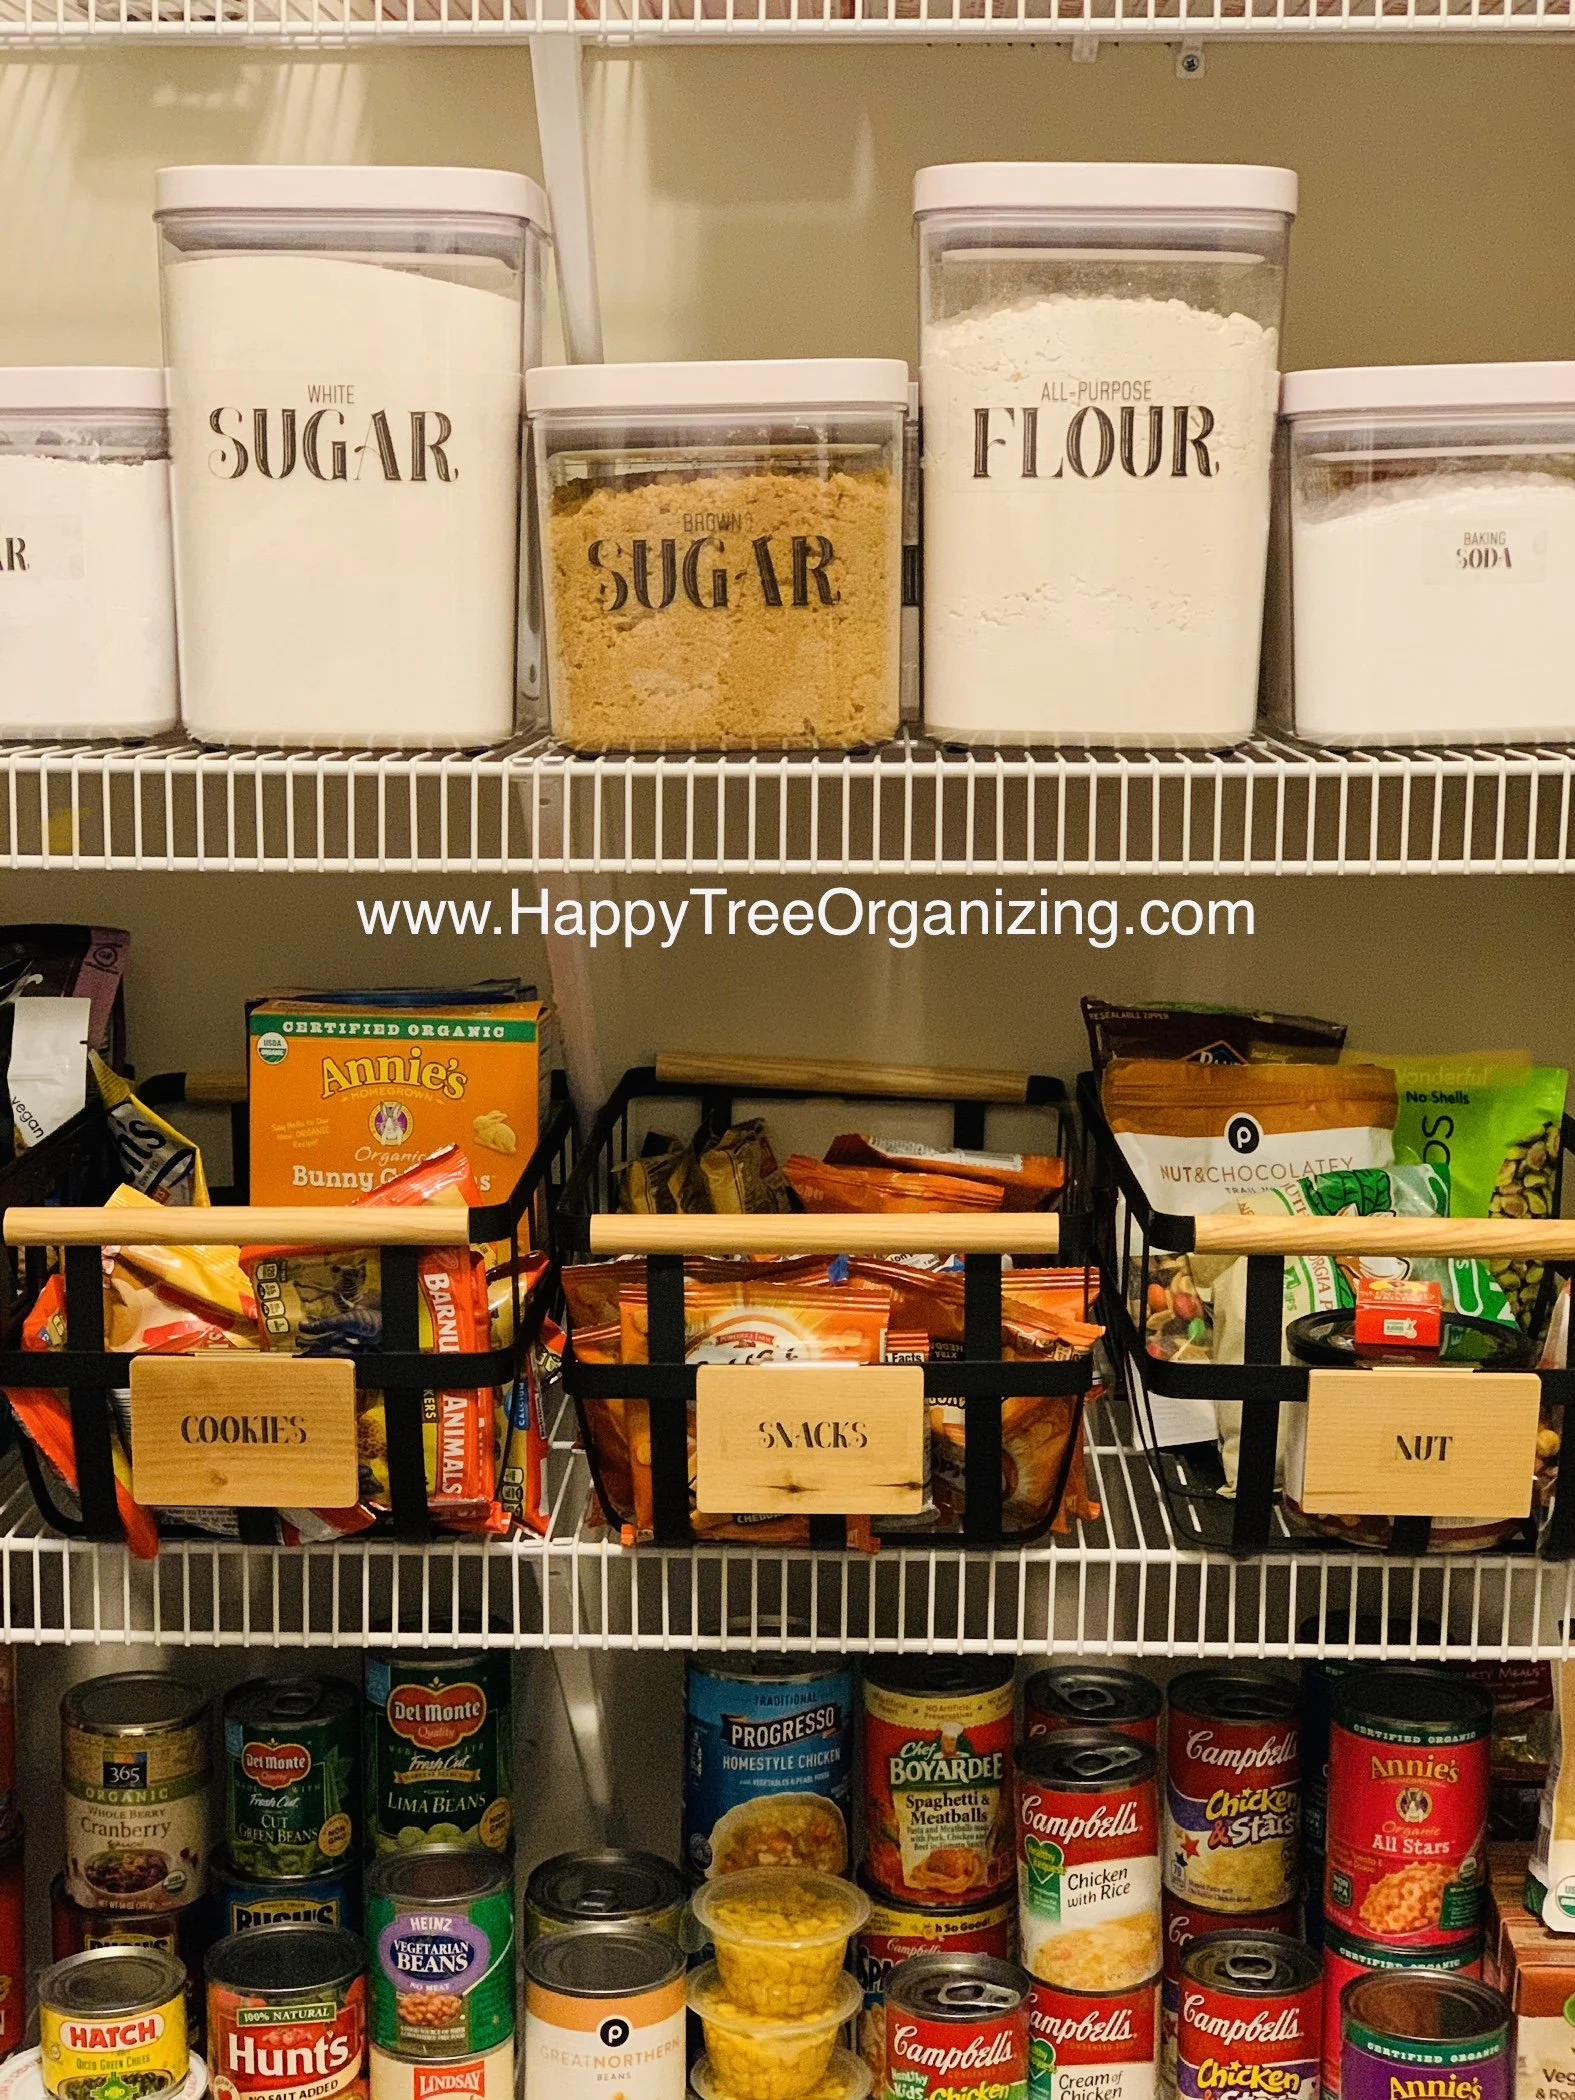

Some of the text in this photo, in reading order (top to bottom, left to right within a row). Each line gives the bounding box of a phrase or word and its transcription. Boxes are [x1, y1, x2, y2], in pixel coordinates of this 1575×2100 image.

[307, 383, 355, 404] WHITE
[1041, 380, 1152, 401] ALL-PURPOSE
[208, 407, 459, 482] SUGAR
[971, 404, 1220, 479] FLOUR
[683, 513, 742, 532] BROWN
[1463, 531, 1506, 546] BAKING
[0, 536, 30, 571] R
[1455, 547, 1513, 570] SODA
[587, 535, 841, 611] SUGAR
[282, 1020, 505, 1039] CERTIFIED ORGANIC
[263, 1039, 282, 1047] USDA
[321, 1046, 468, 1101] Annie's
[350, 1086, 434, 1103] HOMEGROWN
[1405, 1090, 1471, 1105] No Shells
[10, 1096, 45, 1139] vegan
[292, 1165, 374, 1192] Bunny
[891, 1352, 923, 1364] Facts
[518, 1382, 526, 1427] CALCIUM
[181, 1415, 307, 1445] COOKIES
[757, 1420, 870, 1450] SNACKS
[441, 1394, 469, 1496] ANIMALS
[1394, 1434, 1454, 1462] NUT
[755, 1693, 817, 1708] TRADITIONAL
[394, 1701, 481, 1723] Del Monte
[418, 1725, 456, 1740] Quality
[731, 1706, 835, 1749] PROGRESSO
[1353, 1722, 1477, 1745] CERTIFIED ORGANIC
[723, 1748, 842, 1772] HOMESTYLE CHICKEN
[900, 1740, 936, 1760] Chef
[1186, 1729, 1298, 1776] Campbell's
[245, 1752, 307, 1771] Del Monte
[408, 1754, 471, 1772] Fresh Cut
[889, 1752, 1003, 1786] BOYARDEE
[1370, 1753, 1461, 1785] Annie's
[109, 1765, 142, 1785] 365
[85, 1787, 169, 1803] ORGANIC
[249, 1792, 278, 1809] Fresh
[388, 1791, 486, 1815] LIMA BEANS
[905, 1792, 991, 1812] Spaghetti &
[1205, 1786, 1297, 1822] Chicken
[80, 1815, 173, 1840] Cranberry
[260, 1814, 289, 1830] CUT
[910, 1810, 988, 1826] Meatballs
[1021, 1793, 1140, 1845] Campbell's
[1381, 1820, 1442, 1838] Organic
[239, 1823, 319, 1844] GREEN BEANS
[1208, 1812, 1296, 1850] & Stars
[1371, 1833, 1451, 1856] All Stars
[1067, 1866, 1129, 1892] Chicken
[1066, 1882, 1131, 1909] with Rice
[410, 1916, 453, 1932] HEINZ
[944, 1916, 991, 1933] So Good!
[394, 1938, 469, 1955] VEGETARIAN
[396, 1953, 469, 1974] BEANS
[1339, 1947, 1404, 1969] CERTIFIED
[409, 1981, 452, 1992] NO MEAT
[243, 2006, 331, 2024] 100% NATURAL
[1183, 1990, 1301, 2047] Campbell's
[69, 2018, 157, 2050] HATCH
[228, 2029, 350, 2078] Hunt's
[893, 2022, 1014, 2076] Campbell's
[1366, 2041, 1500, 2064] CERTIFIED ORGANIC
[76, 2053, 152, 2071] DICED GREEN CHILES
[418, 2070, 481, 2097] LINDSAY
[596, 2072, 633, 2082] BEANS
[1058, 2070, 1125, 2091] Cream of
[1196, 2057, 1301, 2094] Chicken
[1390, 2073, 1484, 2100] Annie's
[268, 2090, 299, 2100] SALT
[299, 2079, 340, 2100] ADDED
[929, 2080, 1011, 2100] Chicken
[1060, 2086, 1123, 2100] Chicken
[1534, 2087, 1546, 2100] &
